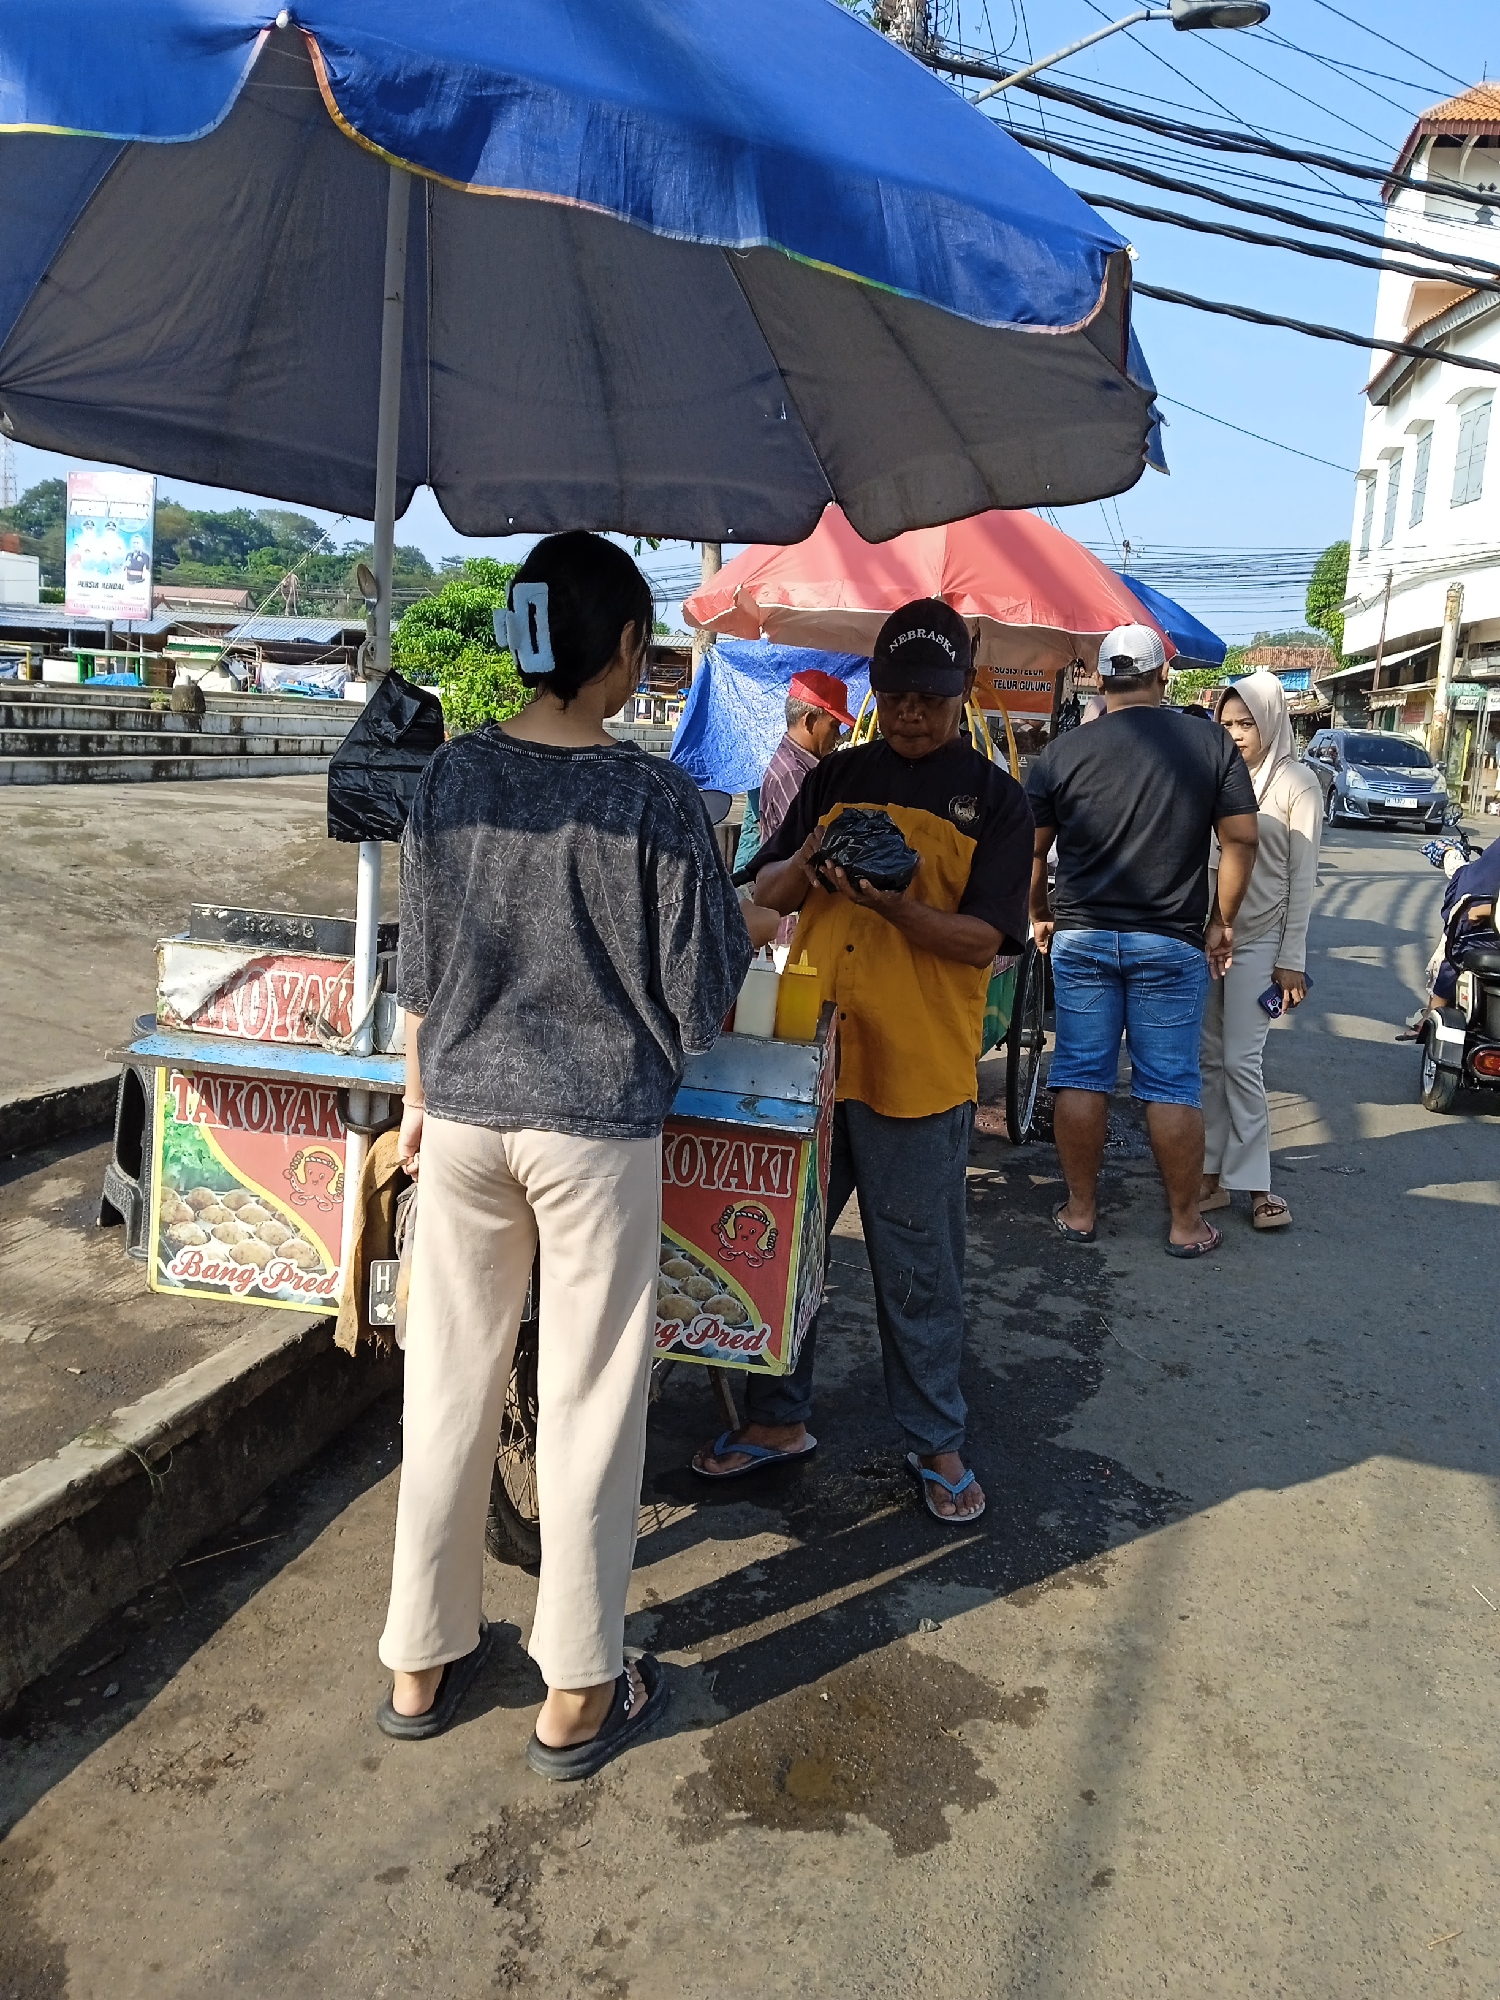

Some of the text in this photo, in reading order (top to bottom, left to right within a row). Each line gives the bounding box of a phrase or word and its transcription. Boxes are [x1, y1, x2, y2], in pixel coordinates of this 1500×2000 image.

[889, 628, 956, 663] NEBRASKA
[993, 679, 1052, 692] TELUR GULUNG
[170, 1074, 347, 1142] TAKOYAK
[172, 1250, 339, 1295] Bang Pred
[376, 1264, 391, 1293] H
[686, 1318, 767, 1352] Pred
